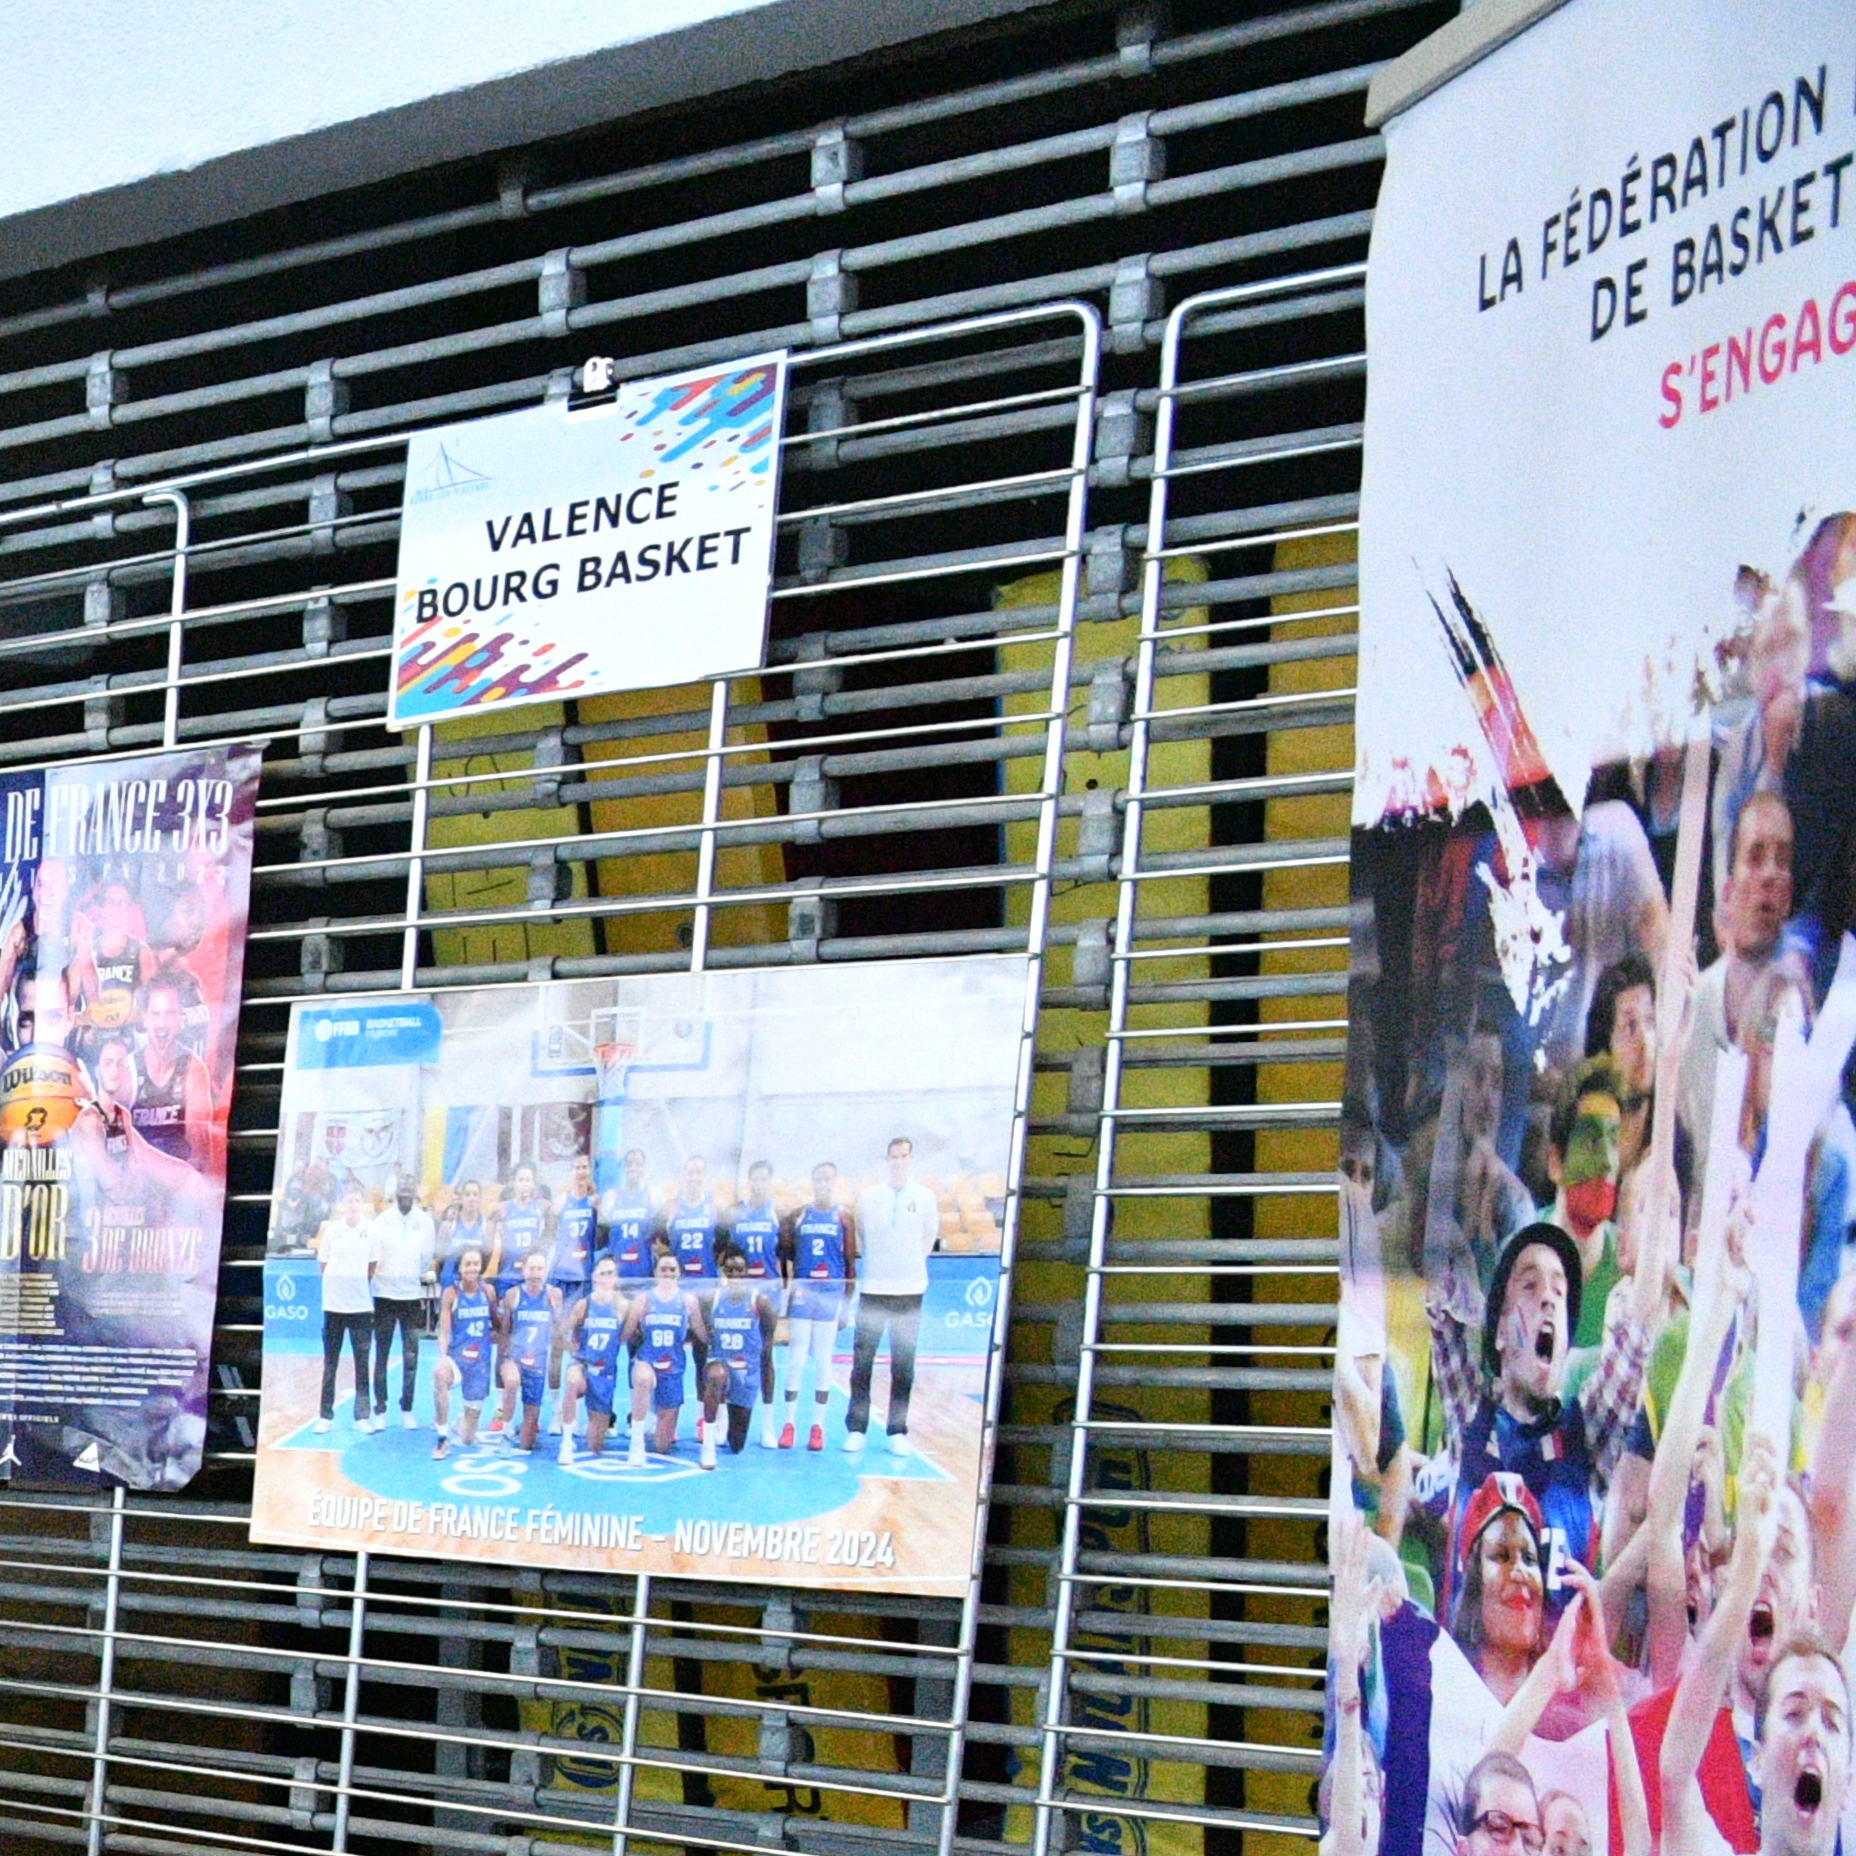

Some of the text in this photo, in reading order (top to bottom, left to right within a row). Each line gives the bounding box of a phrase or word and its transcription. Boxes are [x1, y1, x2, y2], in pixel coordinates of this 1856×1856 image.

[1478, 64, 1827, 312] LA FÉDÉRATION
[1590, 152, 1855, 342] DE BASKET
[485, 481, 680, 552] VALENCE
[415, 527, 751, 624] BOURG BASKET
[4, 788, 41, 864] DE
[49, 779, 167, 857] FRANCE
[681, 1232, 703, 1249] 22
[812, 1238, 824, 1256] 2
[264, 1305, 308, 1320] GASO
[527, 1327, 537, 1343] 7
[307, 1489, 387, 1532] ÉQUIPE
[392, 1500, 424, 1535] DE
[429, 1502, 521, 1542] FRANCE
[526, 1502, 644, 1551] FÉMININE
[674, 1518, 821, 1564] NOVEMBRE
[825, 1530, 897, 1569] 2024
